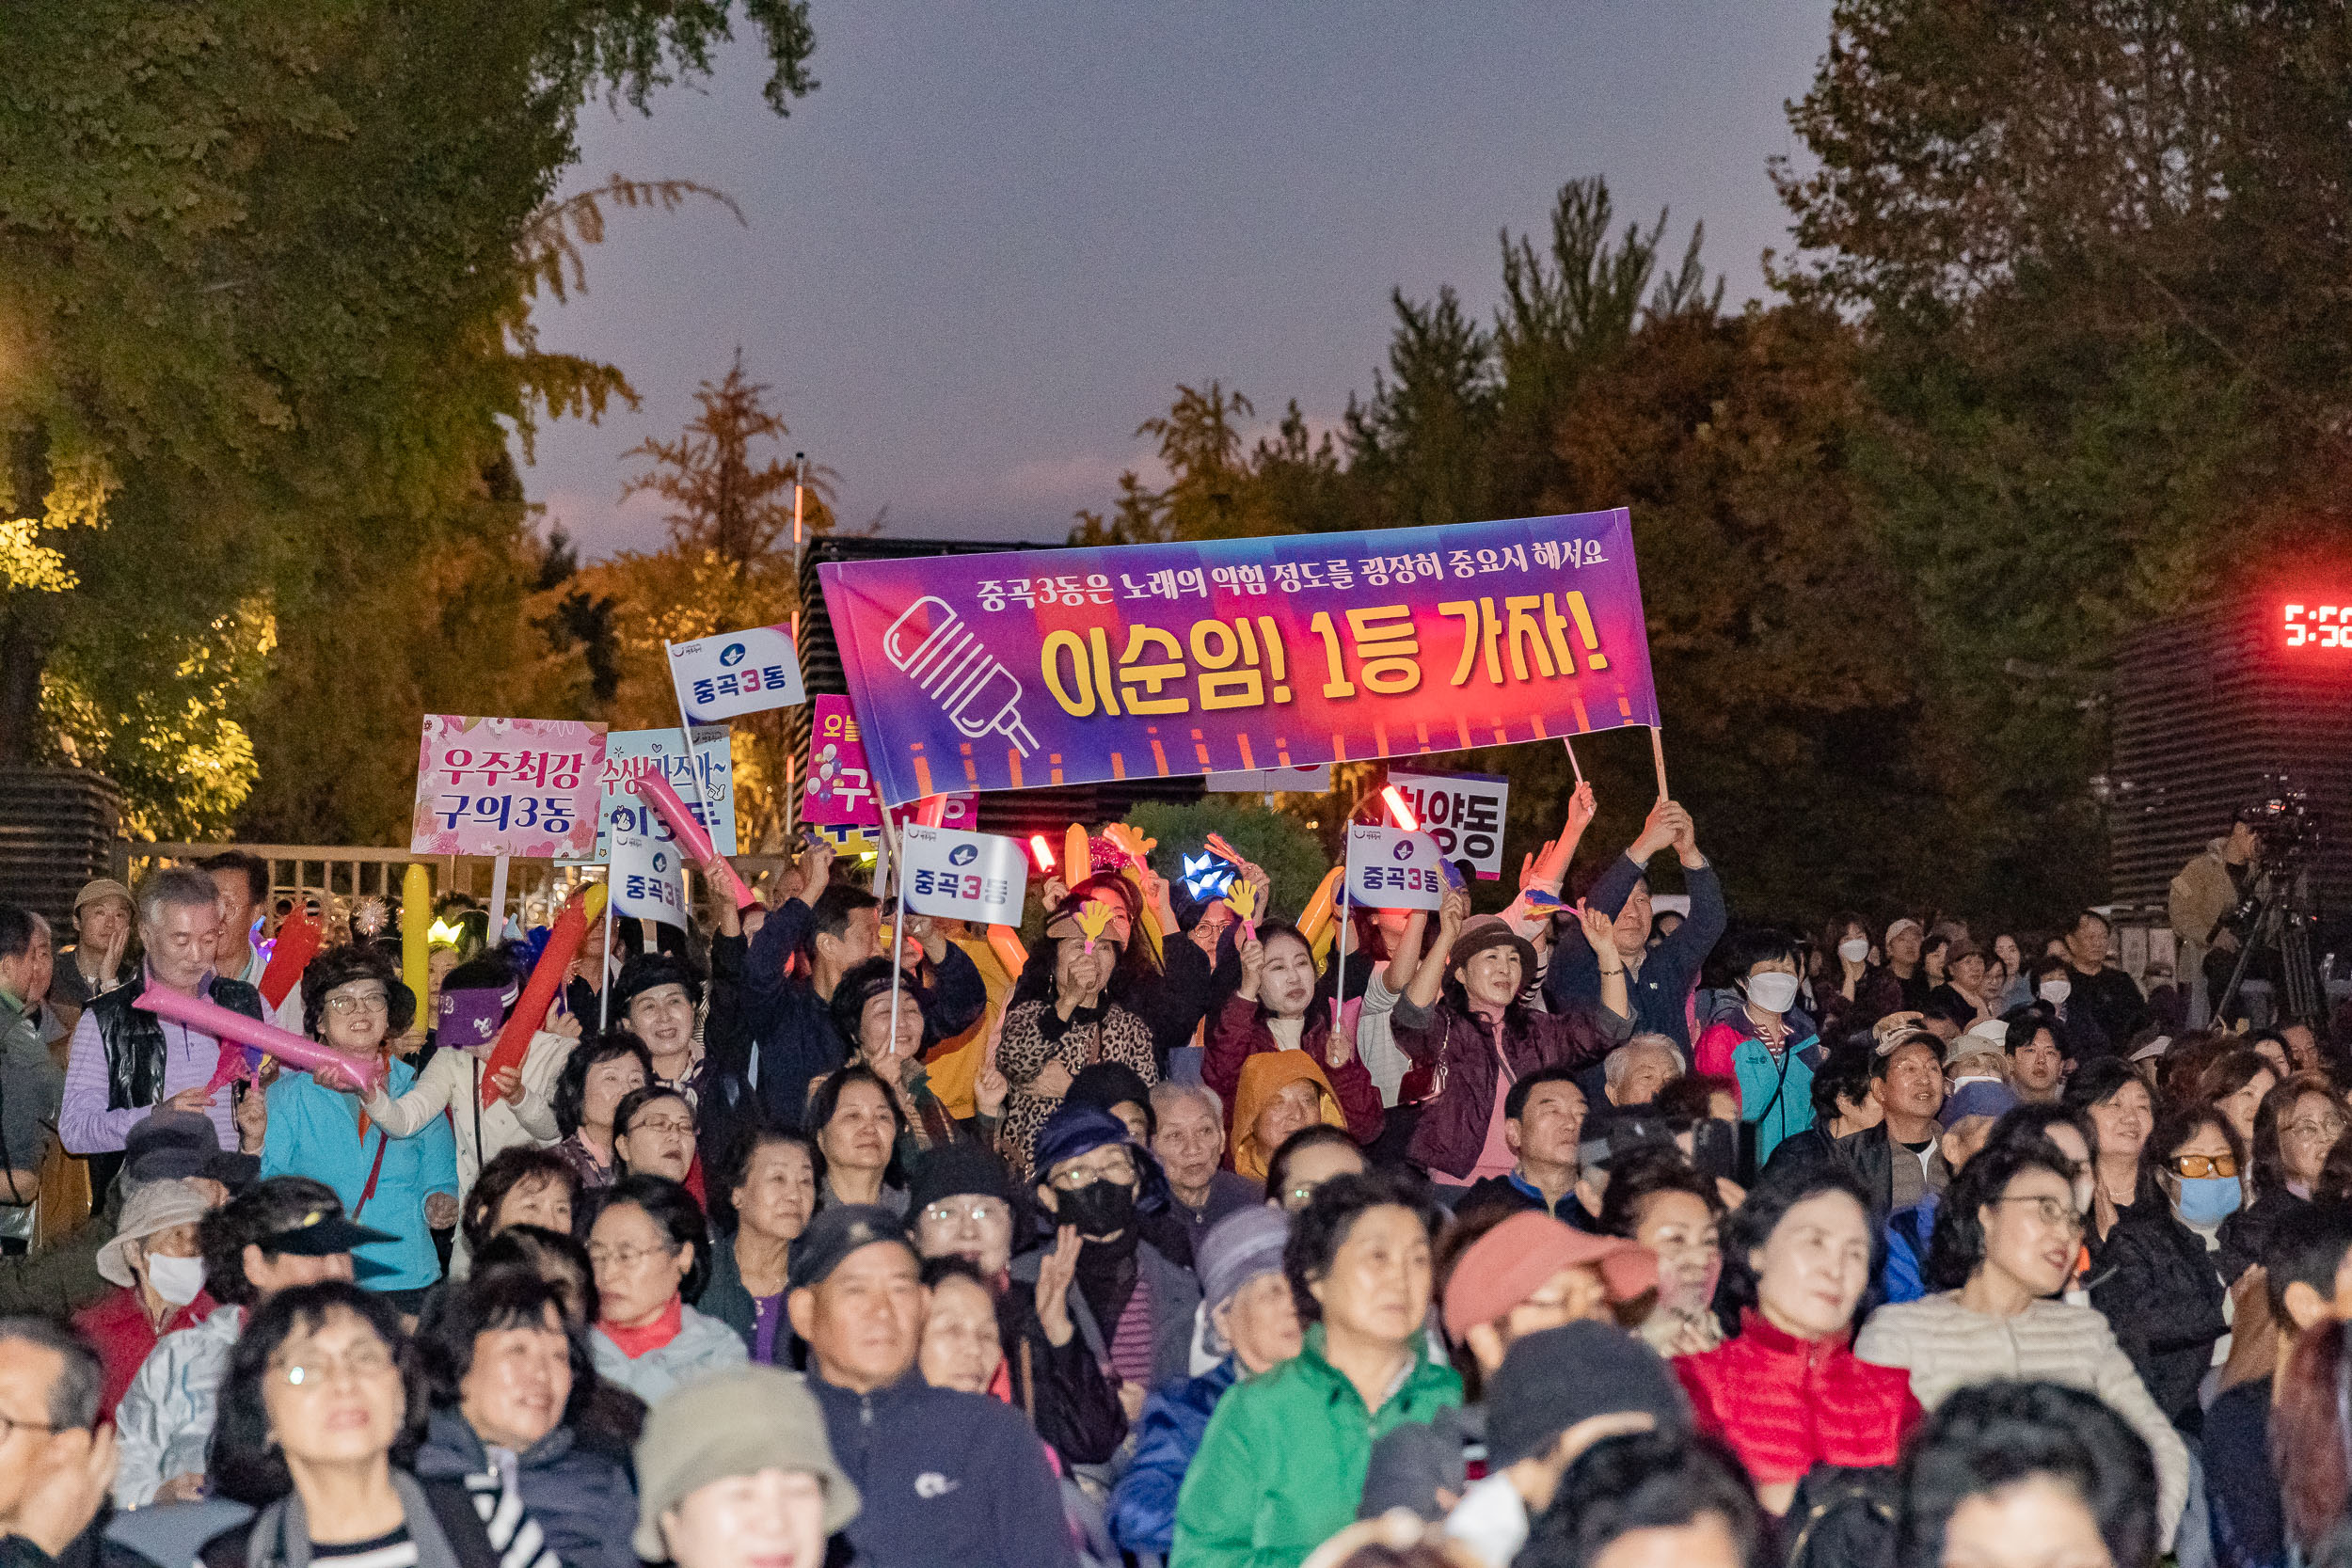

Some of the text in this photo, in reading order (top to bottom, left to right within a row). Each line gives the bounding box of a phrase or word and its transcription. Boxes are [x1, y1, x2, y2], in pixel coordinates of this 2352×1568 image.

[977, 538, 1610, 612] 중곡3동은 노래의 익힘 정도를 굉장히 중요시 해서요
[1041, 590, 1608, 718] 이순임! 1등 가자!
[692, 665, 786, 705] 중곡3동
[439, 749, 585, 789] 우주최강
[436, 795, 575, 833] 구의3동
[914, 868, 1008, 905] 중곡3동
[1363, 866, 1438, 893] 중곡3동
